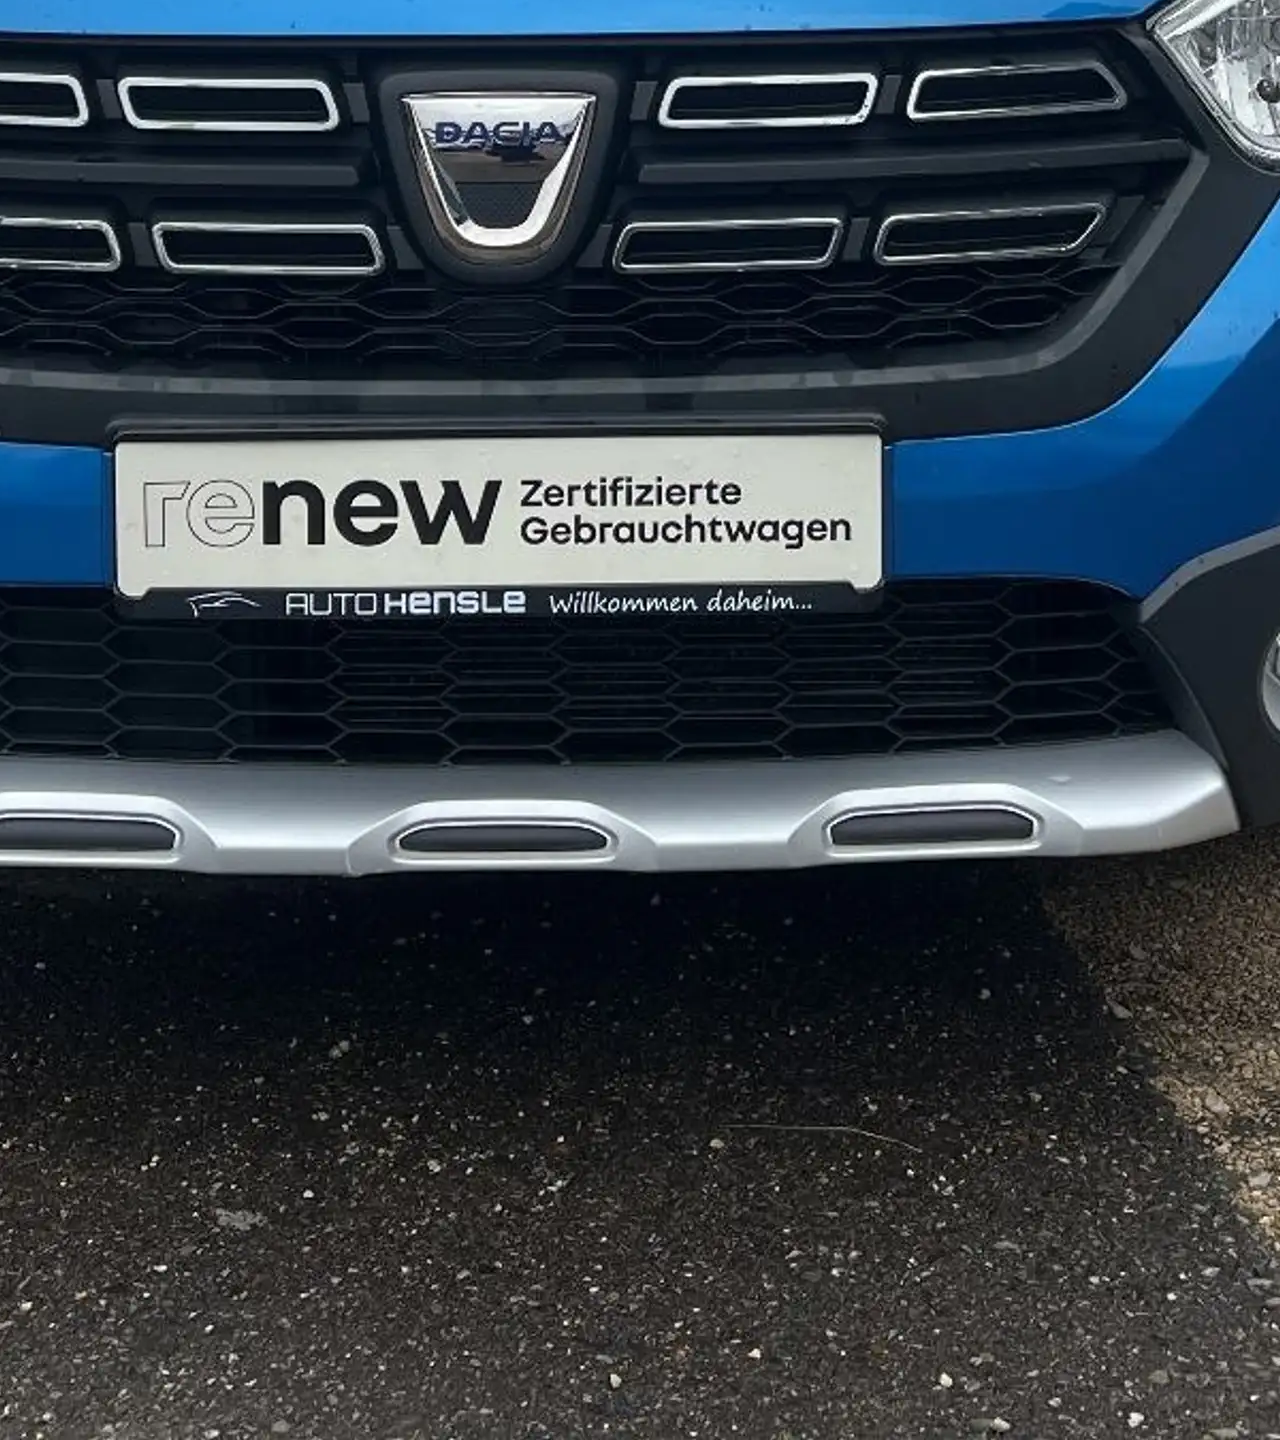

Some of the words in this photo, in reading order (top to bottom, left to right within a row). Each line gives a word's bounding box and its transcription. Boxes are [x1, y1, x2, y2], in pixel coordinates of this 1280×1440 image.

[434, 121, 564, 146] DACIA
[520, 476, 742, 508] Zertifizierte
[143, 479, 503, 548] renew
[520, 514, 853, 550] Gebrauchtwagen
[549, 590, 699, 614] Willkommen
[705, 588, 814, 613] daheim...
